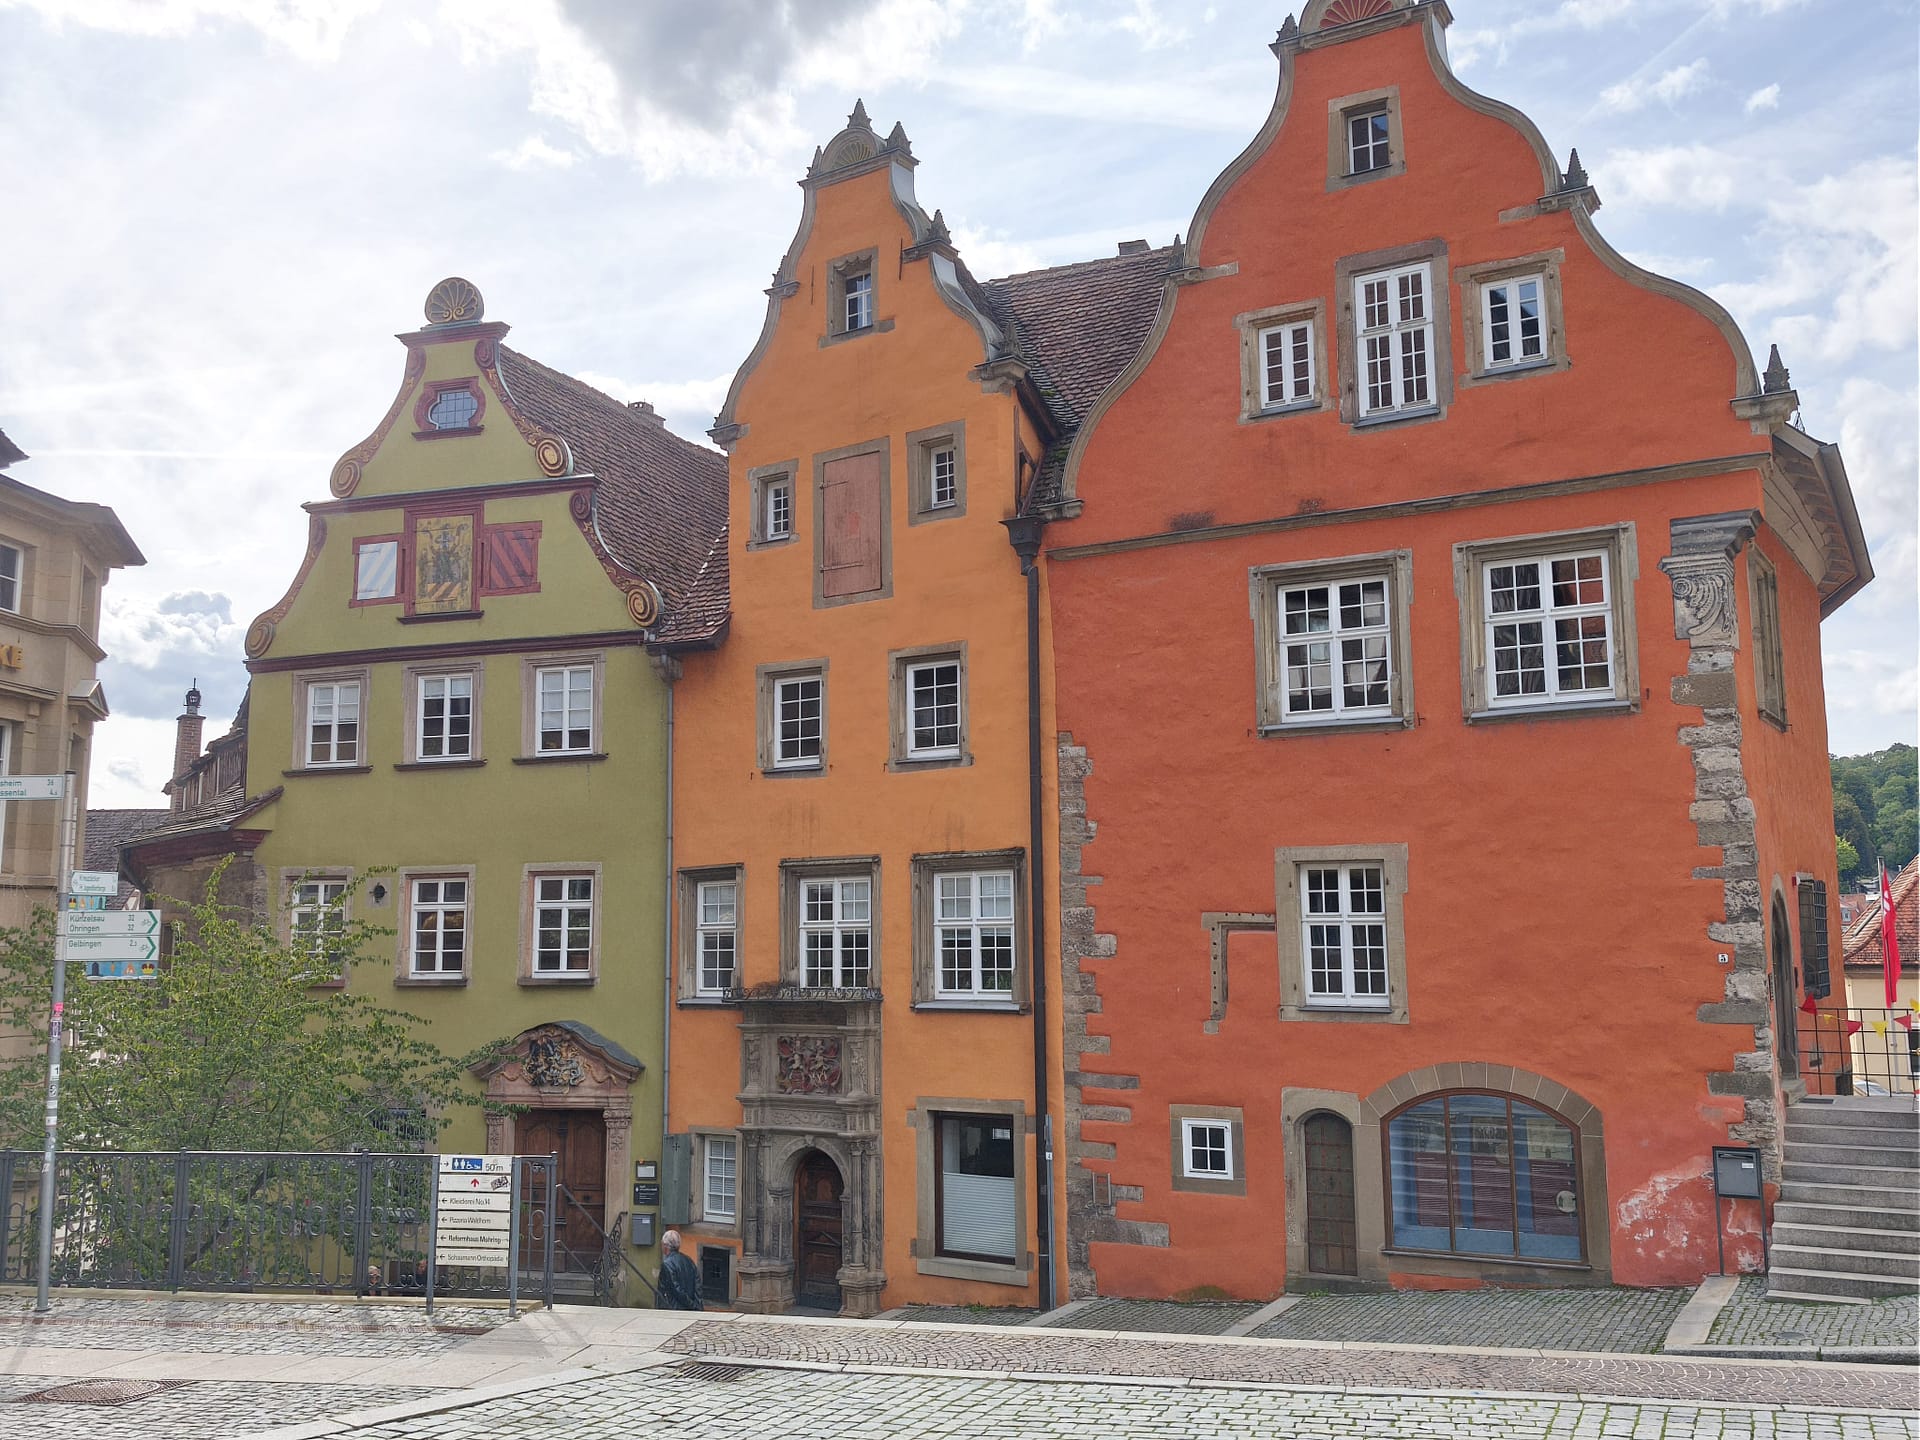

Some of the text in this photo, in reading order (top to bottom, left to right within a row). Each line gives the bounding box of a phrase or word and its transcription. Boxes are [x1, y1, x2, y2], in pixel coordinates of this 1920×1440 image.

[69, 914, 105, 923] Künzelsau
[69, 923, 100, 934] Öhringen
[68, 939, 102, 949] Gelbingen
